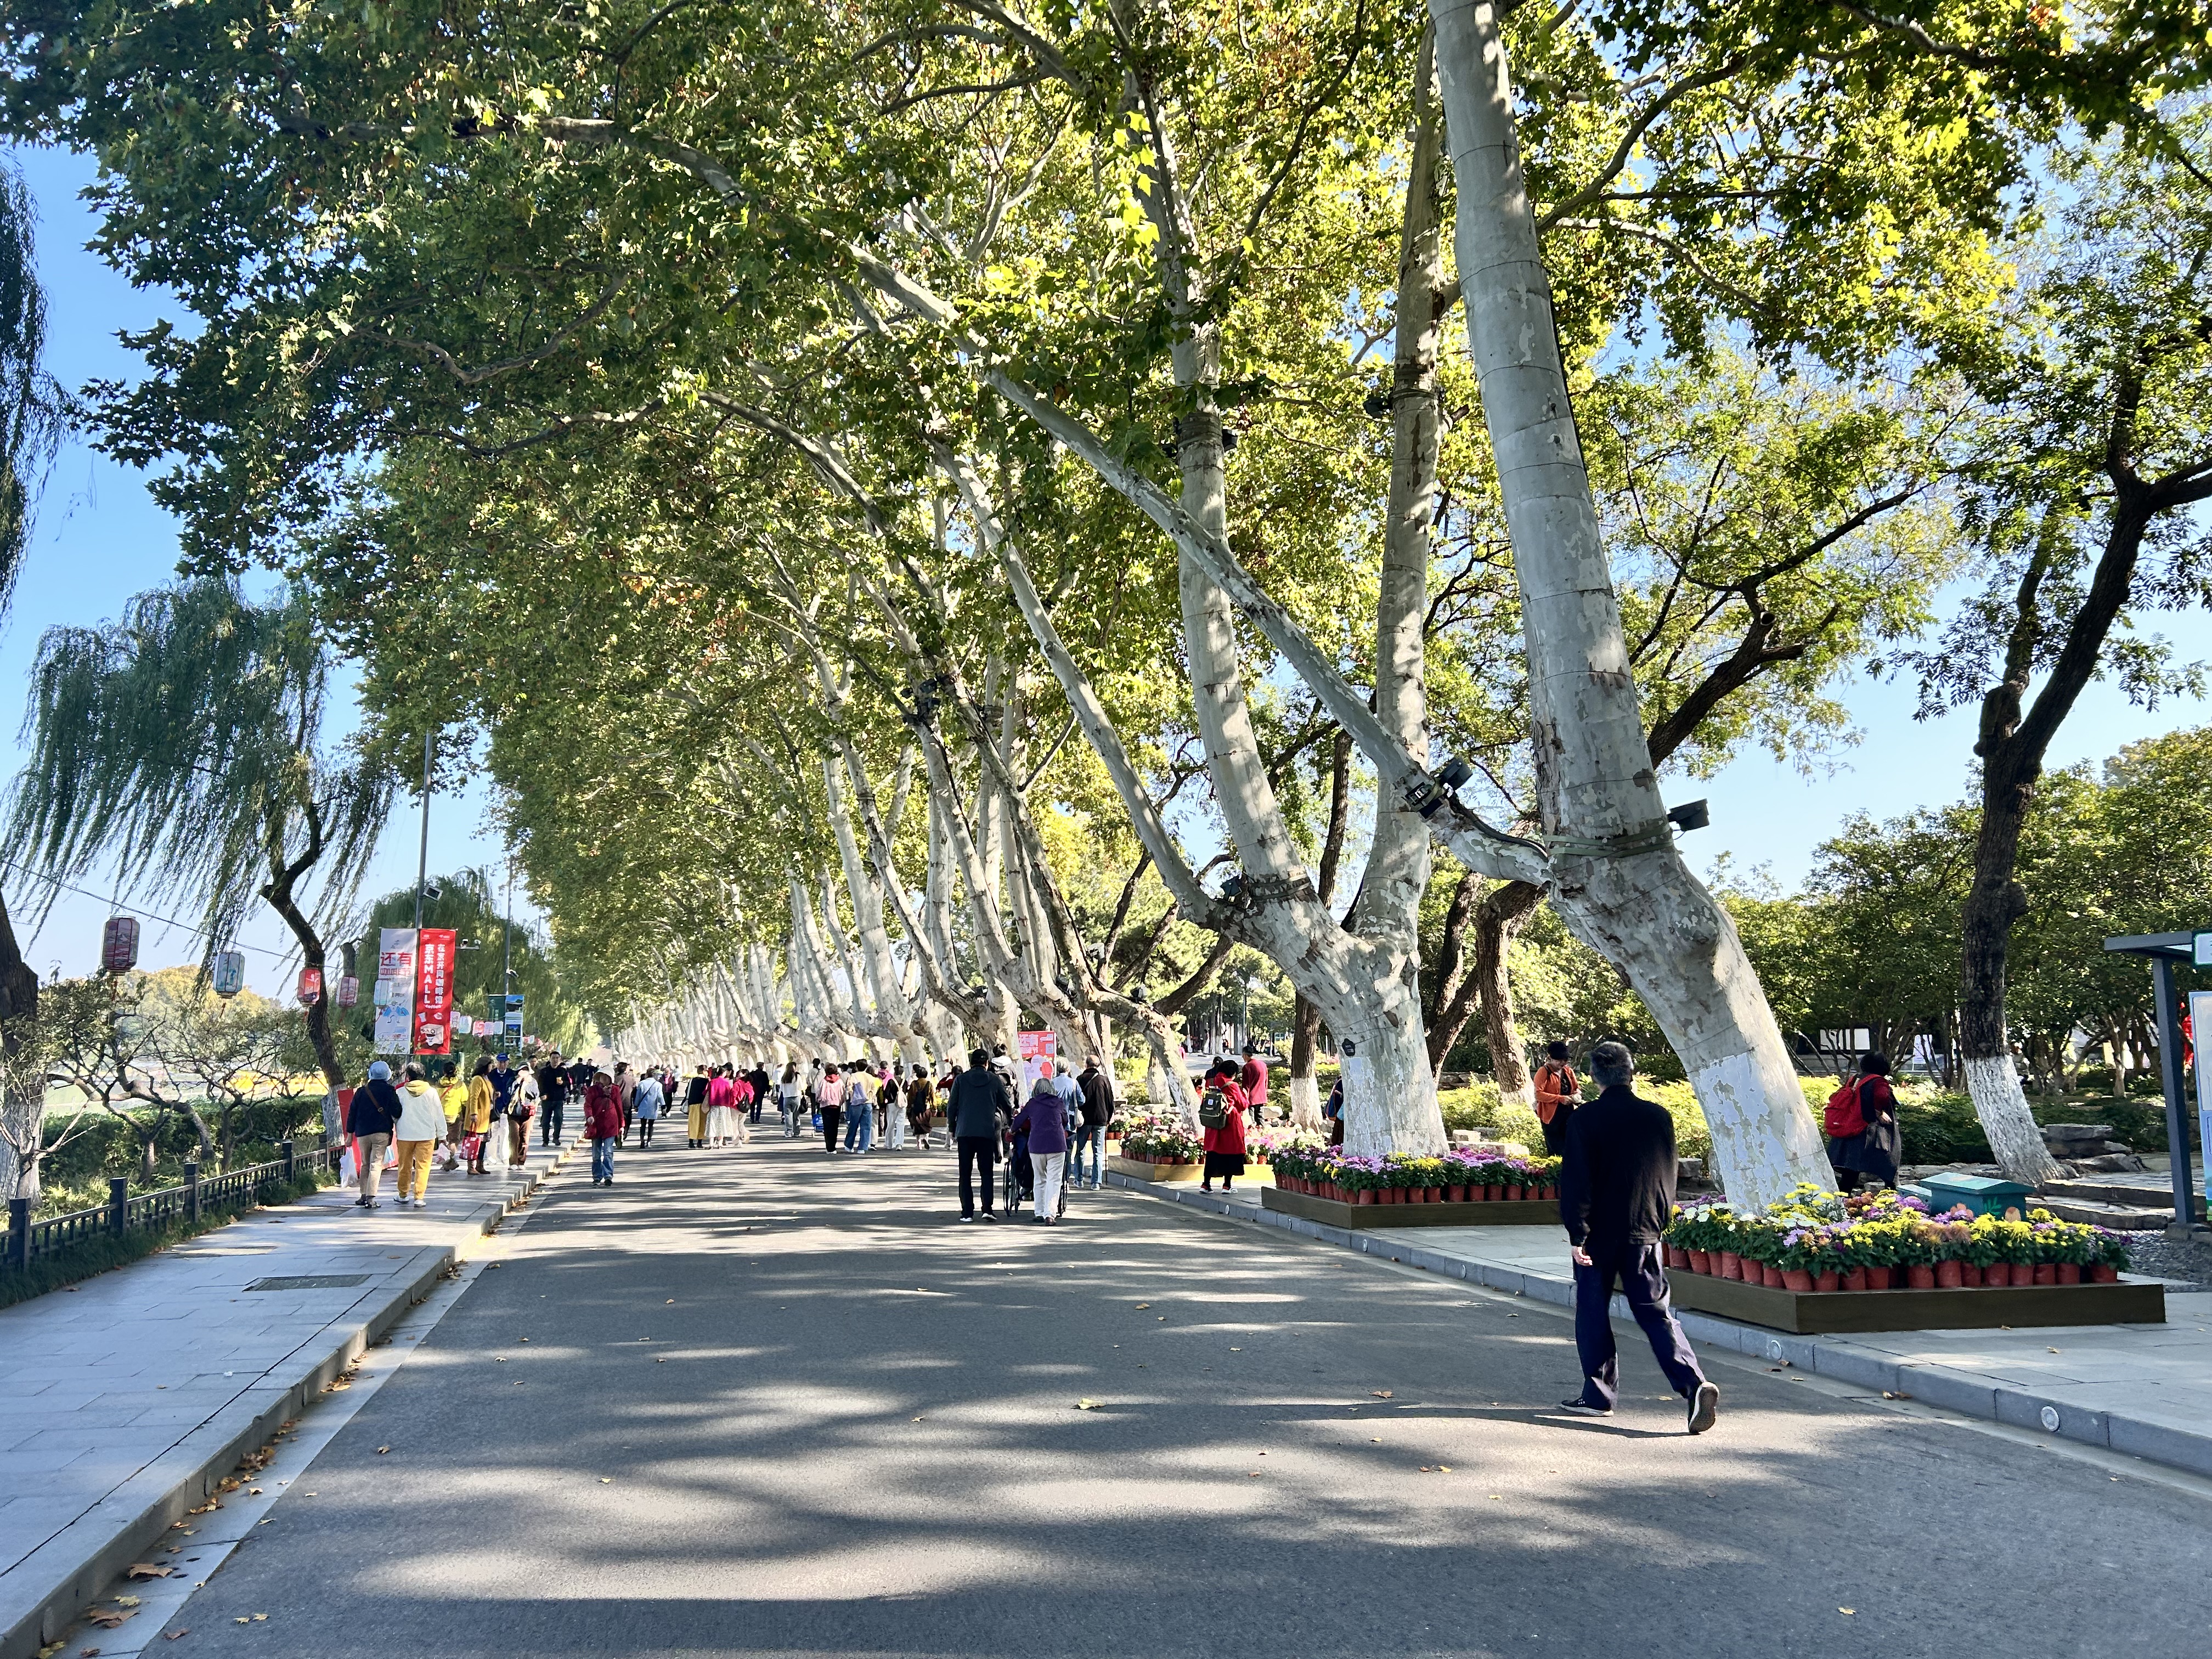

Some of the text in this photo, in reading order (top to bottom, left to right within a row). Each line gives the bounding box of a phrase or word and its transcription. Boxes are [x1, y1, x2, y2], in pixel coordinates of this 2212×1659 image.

[380, 952, 413, 966] 还有
[424, 944, 435, 1004] 京东MALL
[1018, 1034, 1039, 1047] 还有
